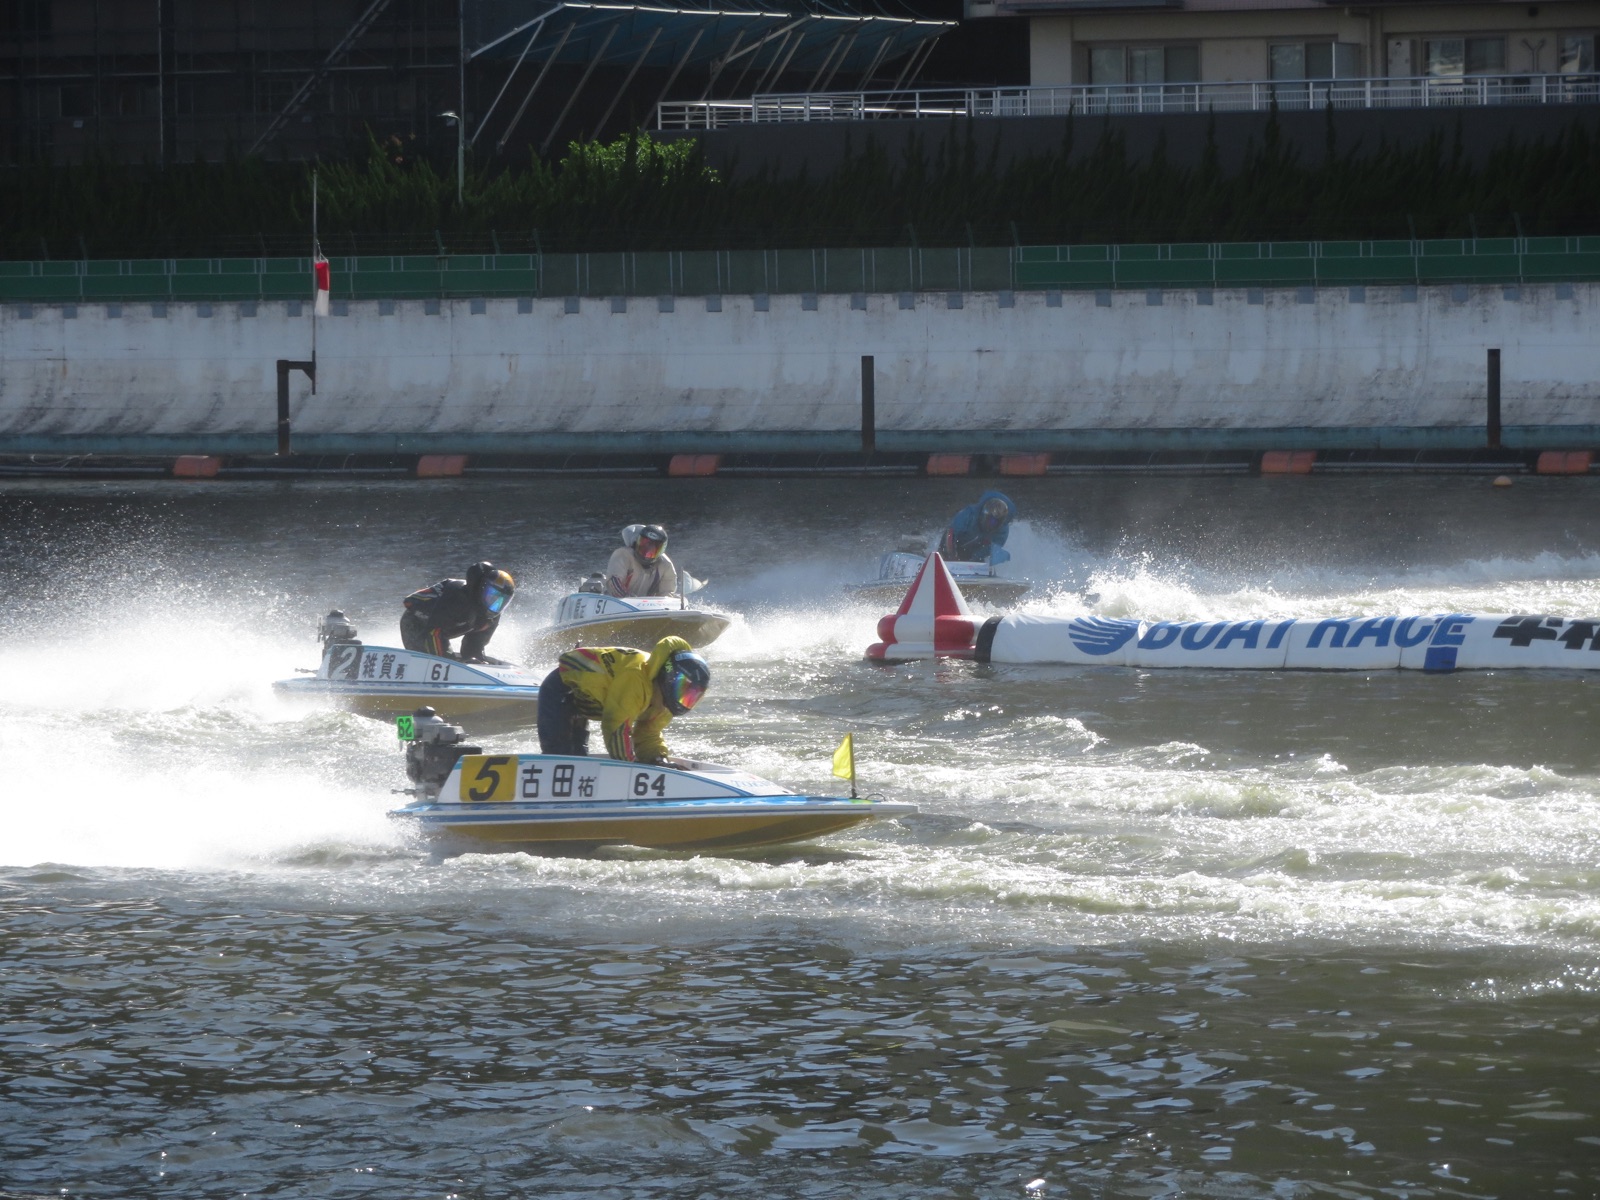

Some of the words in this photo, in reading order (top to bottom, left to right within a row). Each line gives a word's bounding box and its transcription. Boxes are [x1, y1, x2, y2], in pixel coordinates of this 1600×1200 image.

[595, 599, 607, 614] 51
[331, 646, 357, 680] 2
[431, 663, 451, 681] 61
[398, 718, 412, 737] 62
[469, 756, 510, 802] 5
[522, 764, 595, 798] 古田祐
[634, 772, 666, 797] 64
